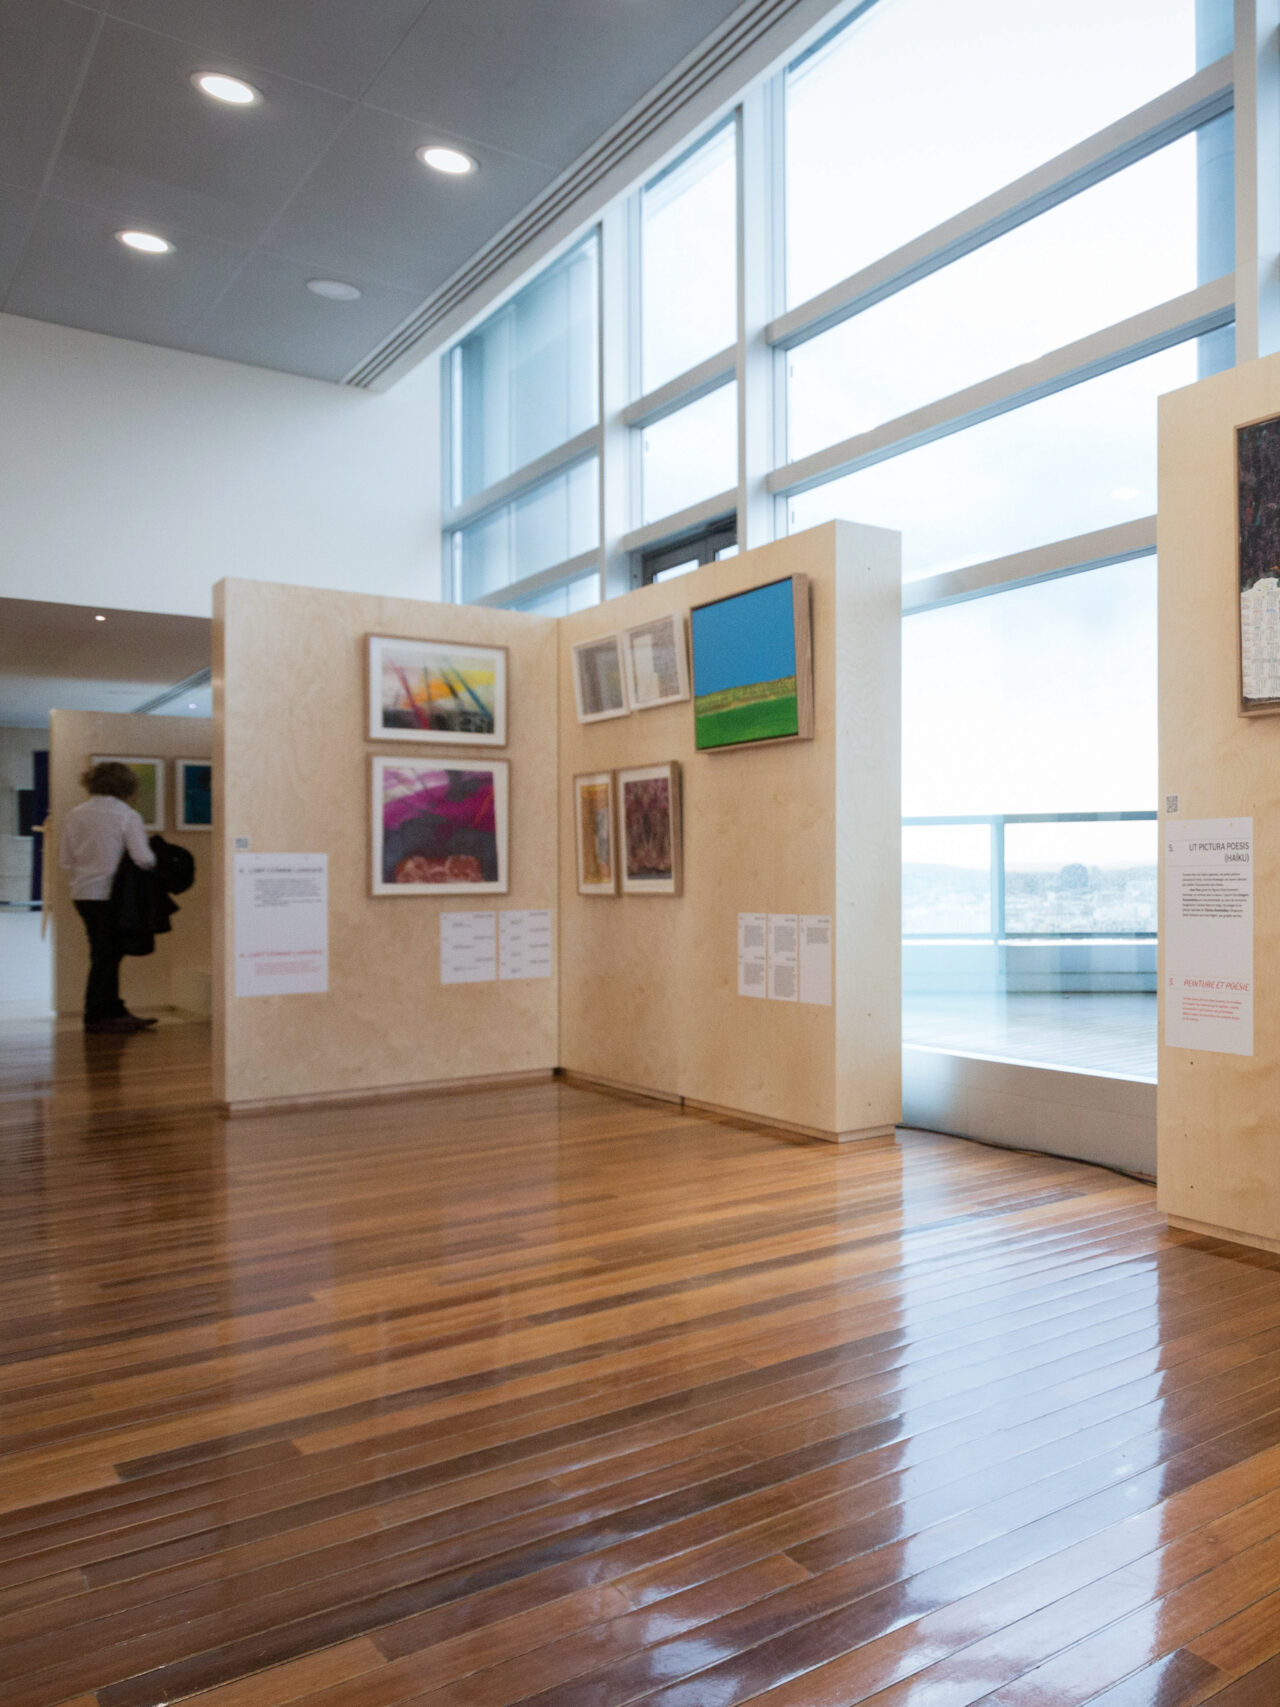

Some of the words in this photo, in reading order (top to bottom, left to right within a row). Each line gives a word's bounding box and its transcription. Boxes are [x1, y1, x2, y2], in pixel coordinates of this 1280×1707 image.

[1189, 844, 1197, 852] UT
[1199, 843, 1225, 851] PICTURA
[1227, 842, 1249, 850] POESIS
[1224, 853, 1250, 863] (HAÏKU)
[1184, 979, 1214, 989] PEINTURE
[1216, 981, 1224, 989] ET
[1226, 981, 1250, 991] POÉSIE
